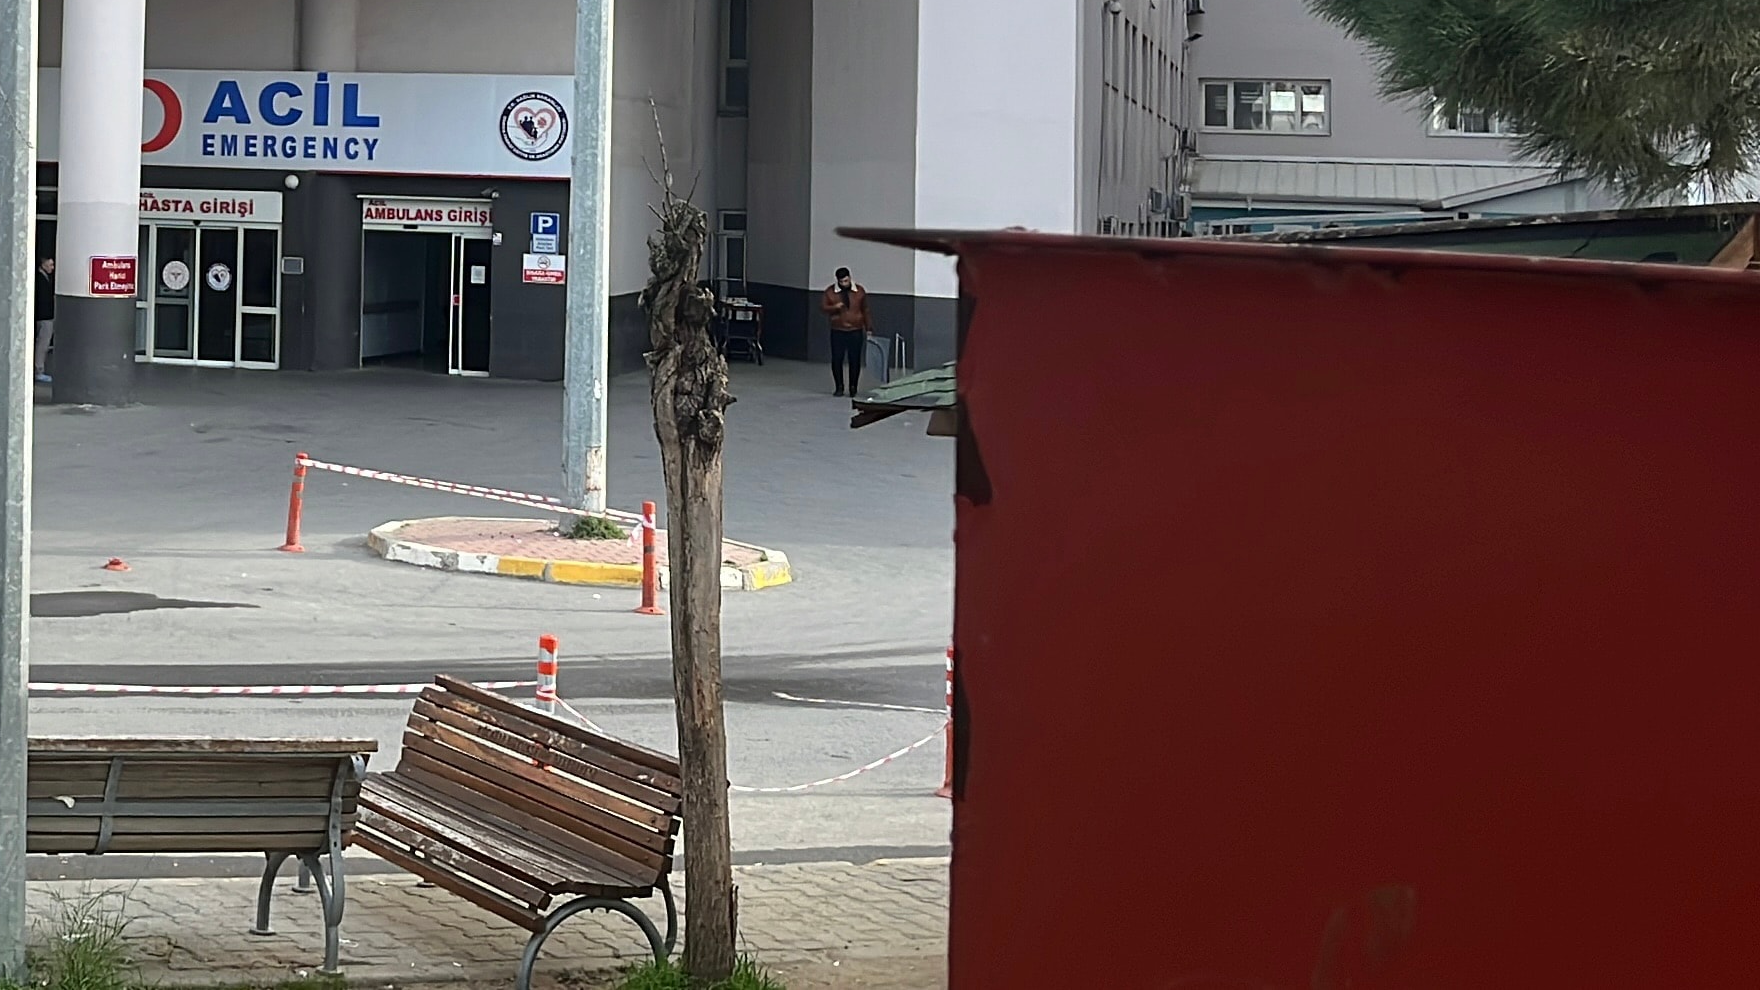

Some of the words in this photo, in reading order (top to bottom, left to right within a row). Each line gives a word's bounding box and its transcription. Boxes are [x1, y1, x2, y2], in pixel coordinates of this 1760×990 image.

[202, 72, 380, 128] ACİL
[202, 134, 379, 161] EMERGENCY
[139, 198, 194, 213] HASTA
[199, 198, 254, 217] GİRİŞİ
[364, 207, 443, 222] AMBULANS
[447, 206, 493, 225] GİRİŞİ
[537, 216, 553, 233] P
